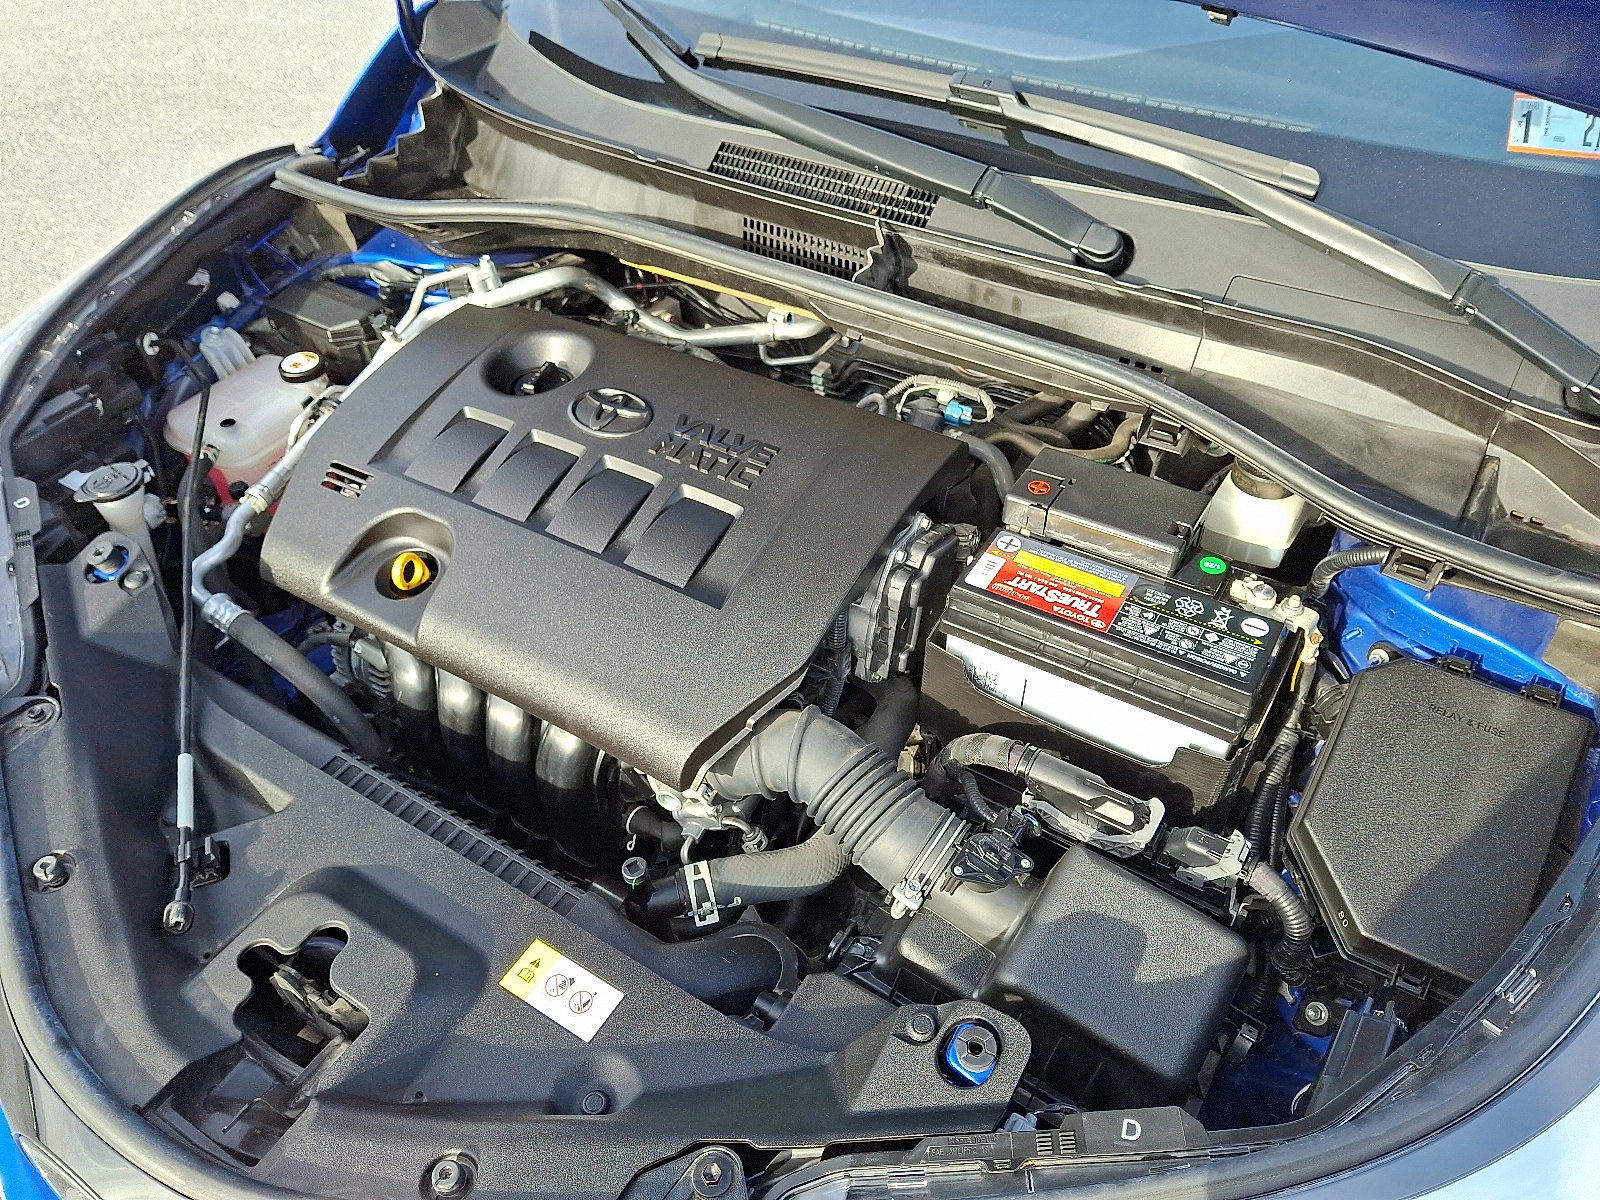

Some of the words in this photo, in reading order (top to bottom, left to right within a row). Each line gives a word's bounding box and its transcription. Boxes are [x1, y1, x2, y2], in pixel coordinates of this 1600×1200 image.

[674, 414, 781, 469] VALVE
[648, 432, 764, 490] MATIC
[1052, 605, 1089, 624] TOYOTA
[1428, 703, 1465, 722] RELAY
[1477, 722, 1506, 739] FUSE
[1121, 1118, 1142, 1141] D
